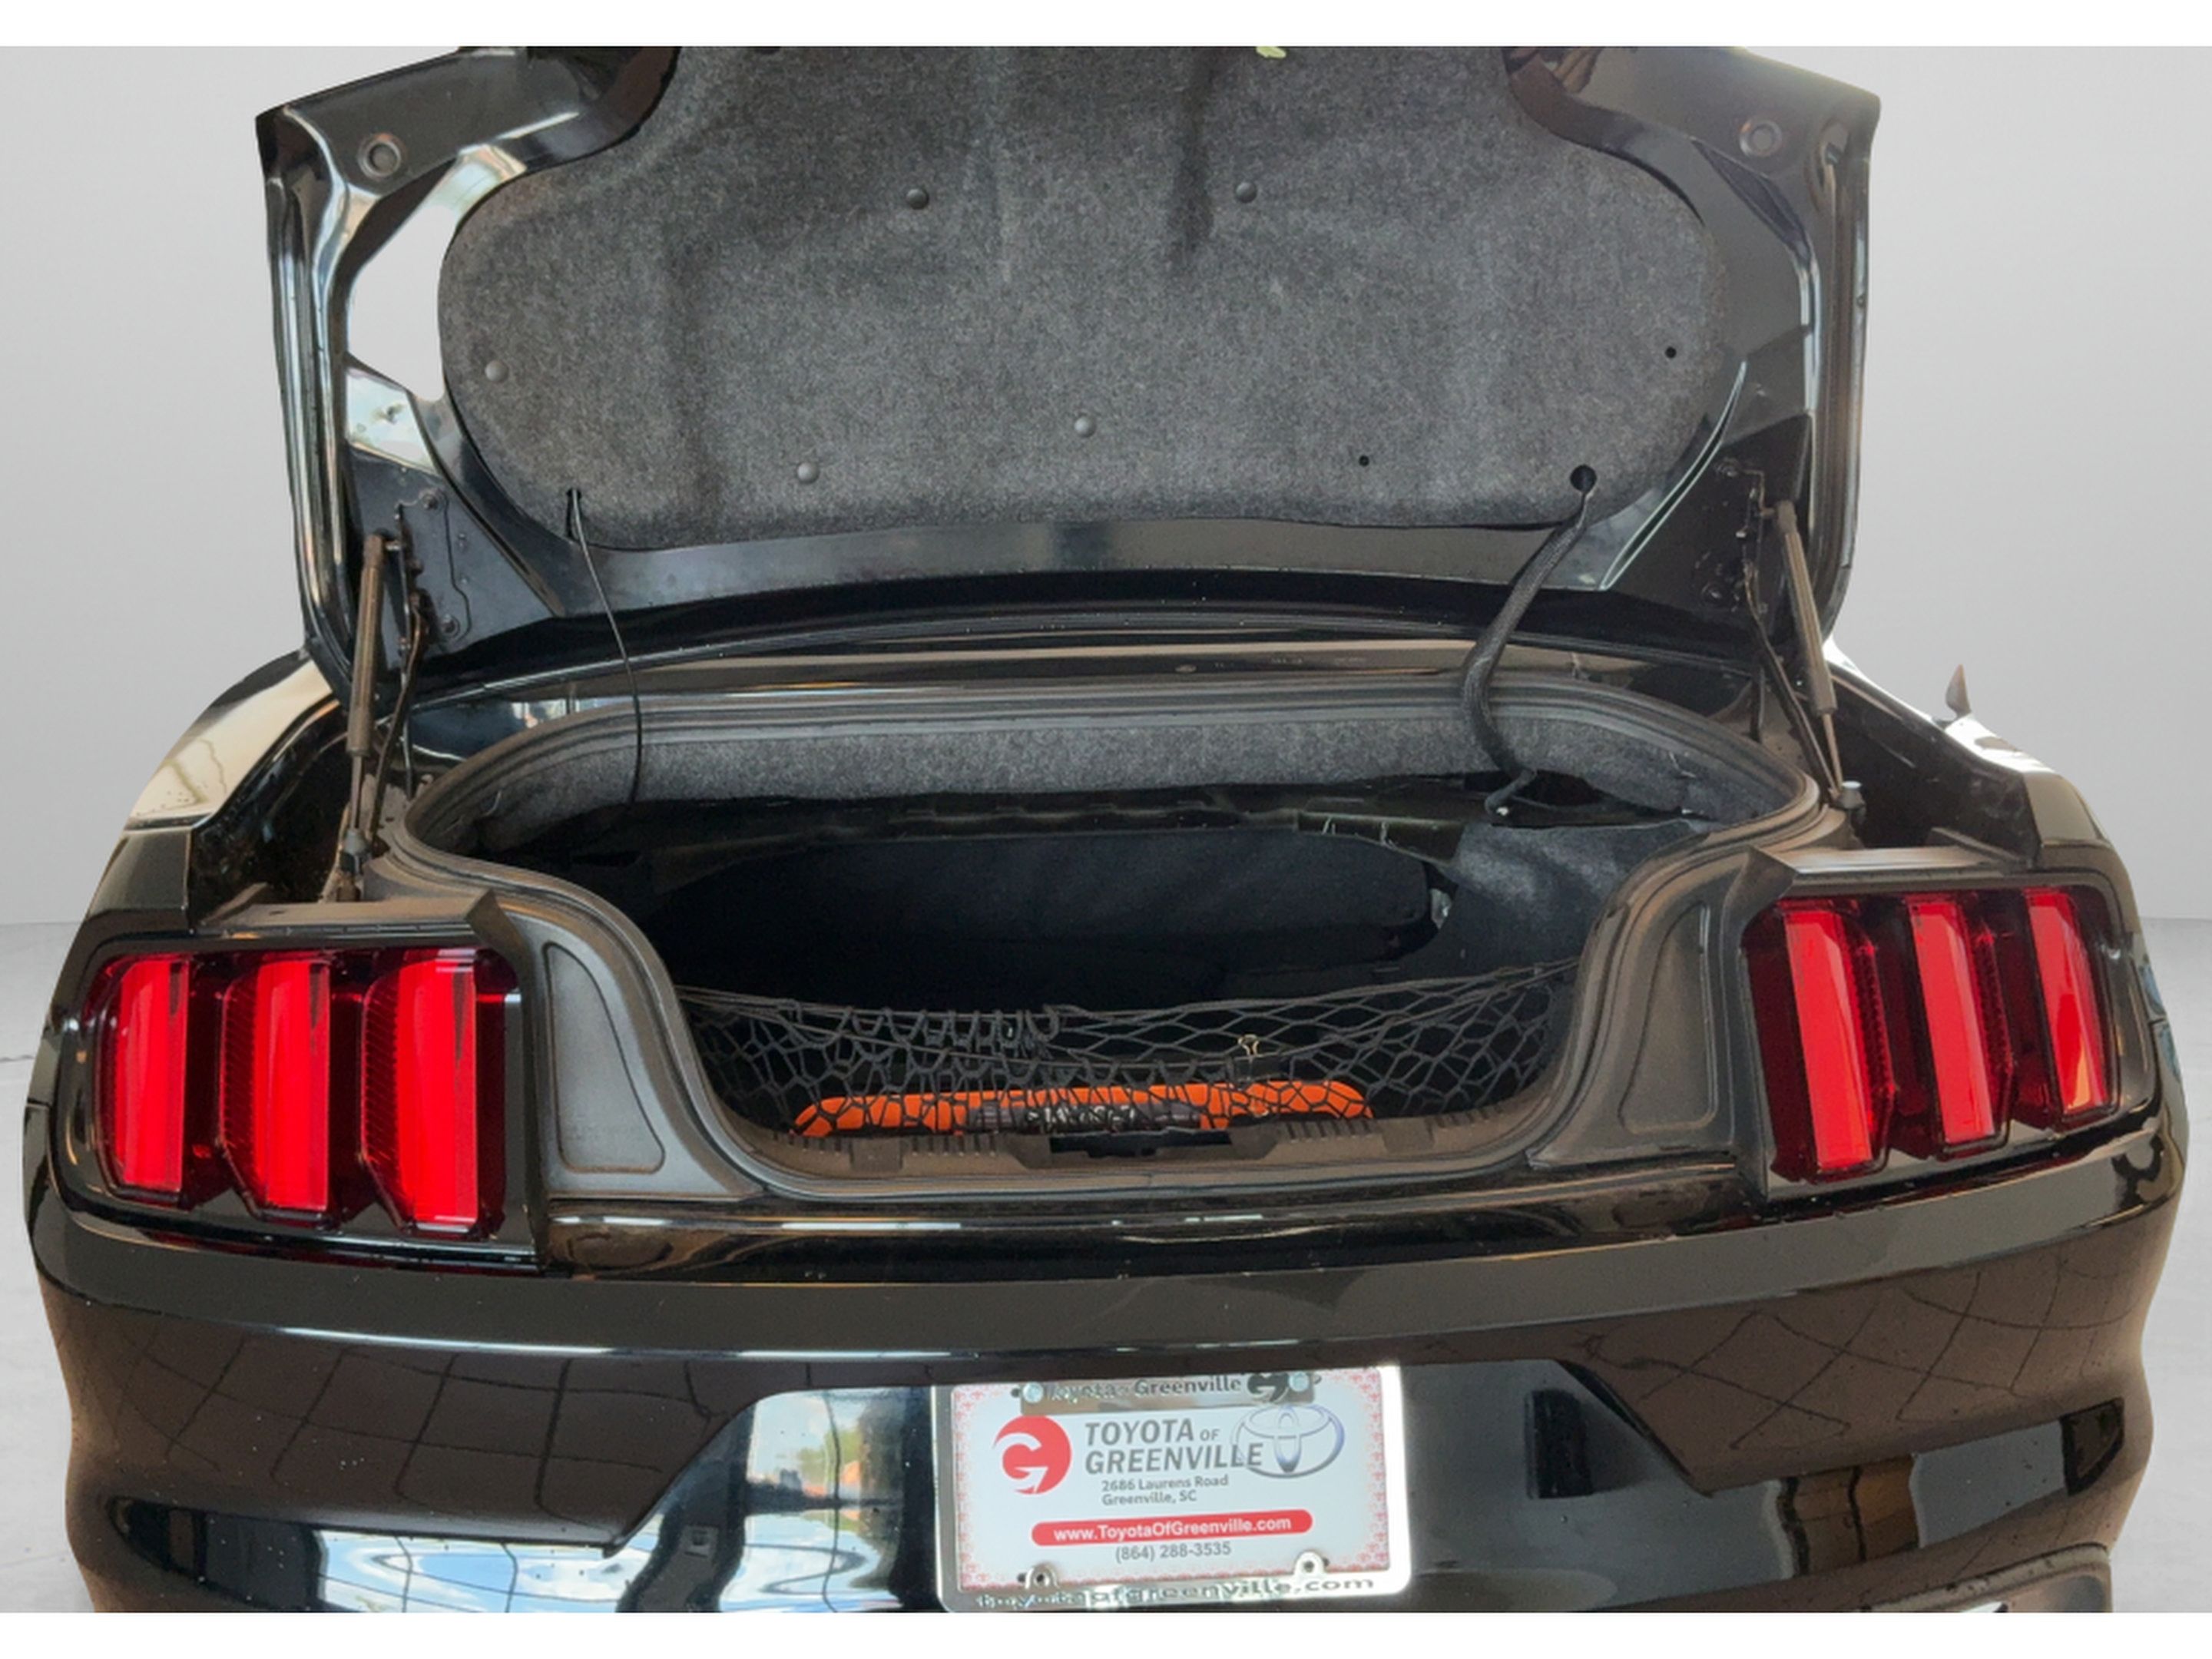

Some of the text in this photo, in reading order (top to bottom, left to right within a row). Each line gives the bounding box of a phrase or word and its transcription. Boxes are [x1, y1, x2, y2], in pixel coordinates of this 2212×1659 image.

[1134, 1375, 1241, 1396] Greenville
[1084, 1418, 1220, 1446] TOYOTA OF
[1084, 1442, 1264, 1475] GREENVILLE
[1101, 1474, 1229, 1492] 2686 Laurens Road
[1101, 1489, 1197, 1506] Greenville, SC
[1052, 1516, 1292, 1542] www.ToyotaOfGreenville.com
[1114, 1541, 1232, 1564] (864) 288-3535
